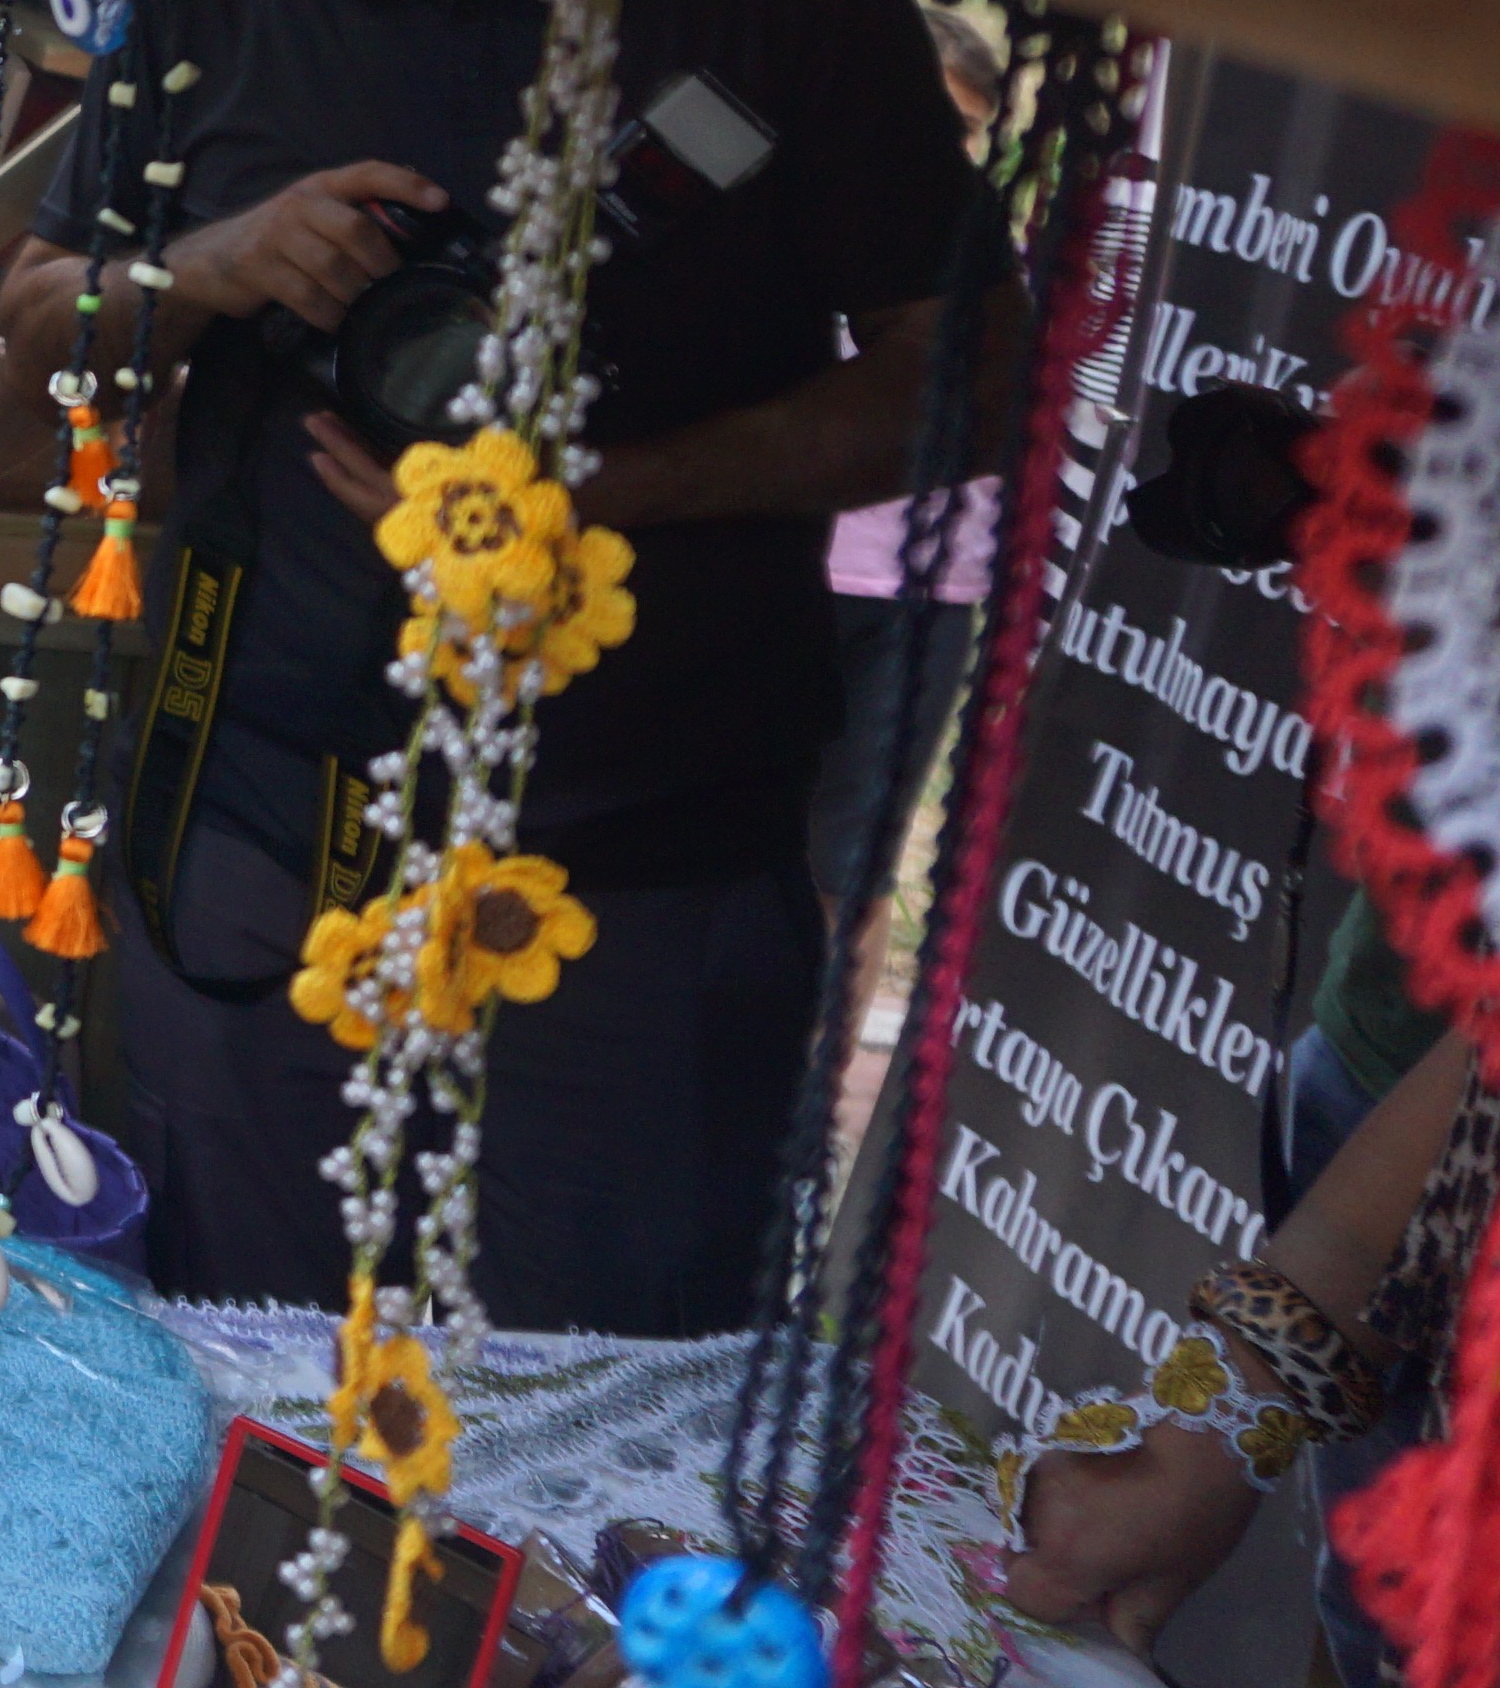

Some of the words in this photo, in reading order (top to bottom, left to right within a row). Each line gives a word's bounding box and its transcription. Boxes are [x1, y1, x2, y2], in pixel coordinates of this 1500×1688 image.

[189, 571, 219, 647] Nikon
[1081, 739, 1271, 943] Tutmuş
[950, 995, 1083, 1128] rtaya
